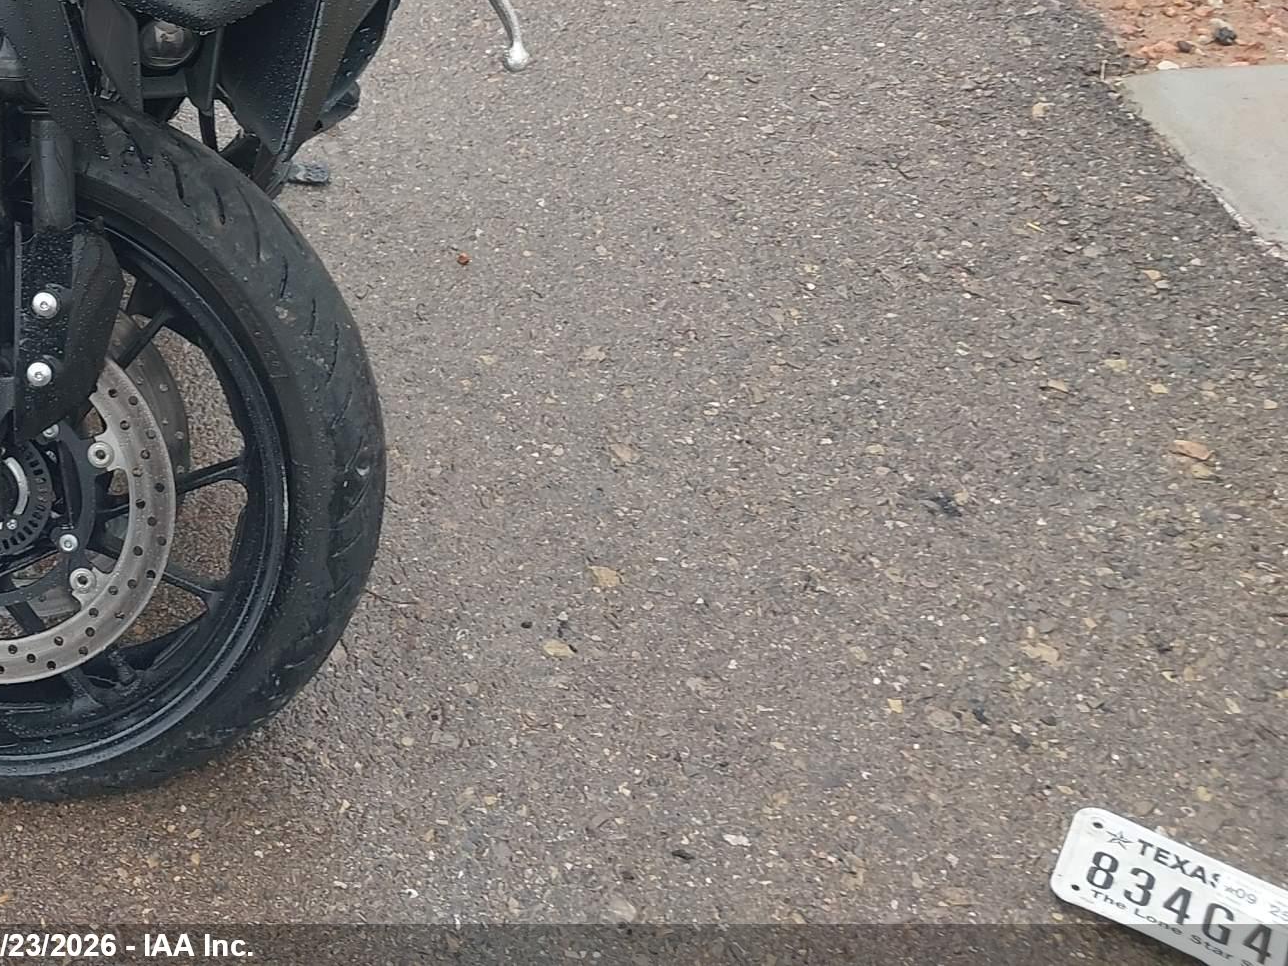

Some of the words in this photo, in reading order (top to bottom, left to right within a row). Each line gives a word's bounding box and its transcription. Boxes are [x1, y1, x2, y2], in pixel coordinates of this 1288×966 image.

[1137, 839, 1221, 888] TEXAS
[1086, 851, 1288, 965] 834G4
[1090, 889, 1126, 910] The
[1134, 907, 1183, 936] Lone
[1189, 933, 1235, 962] Star
